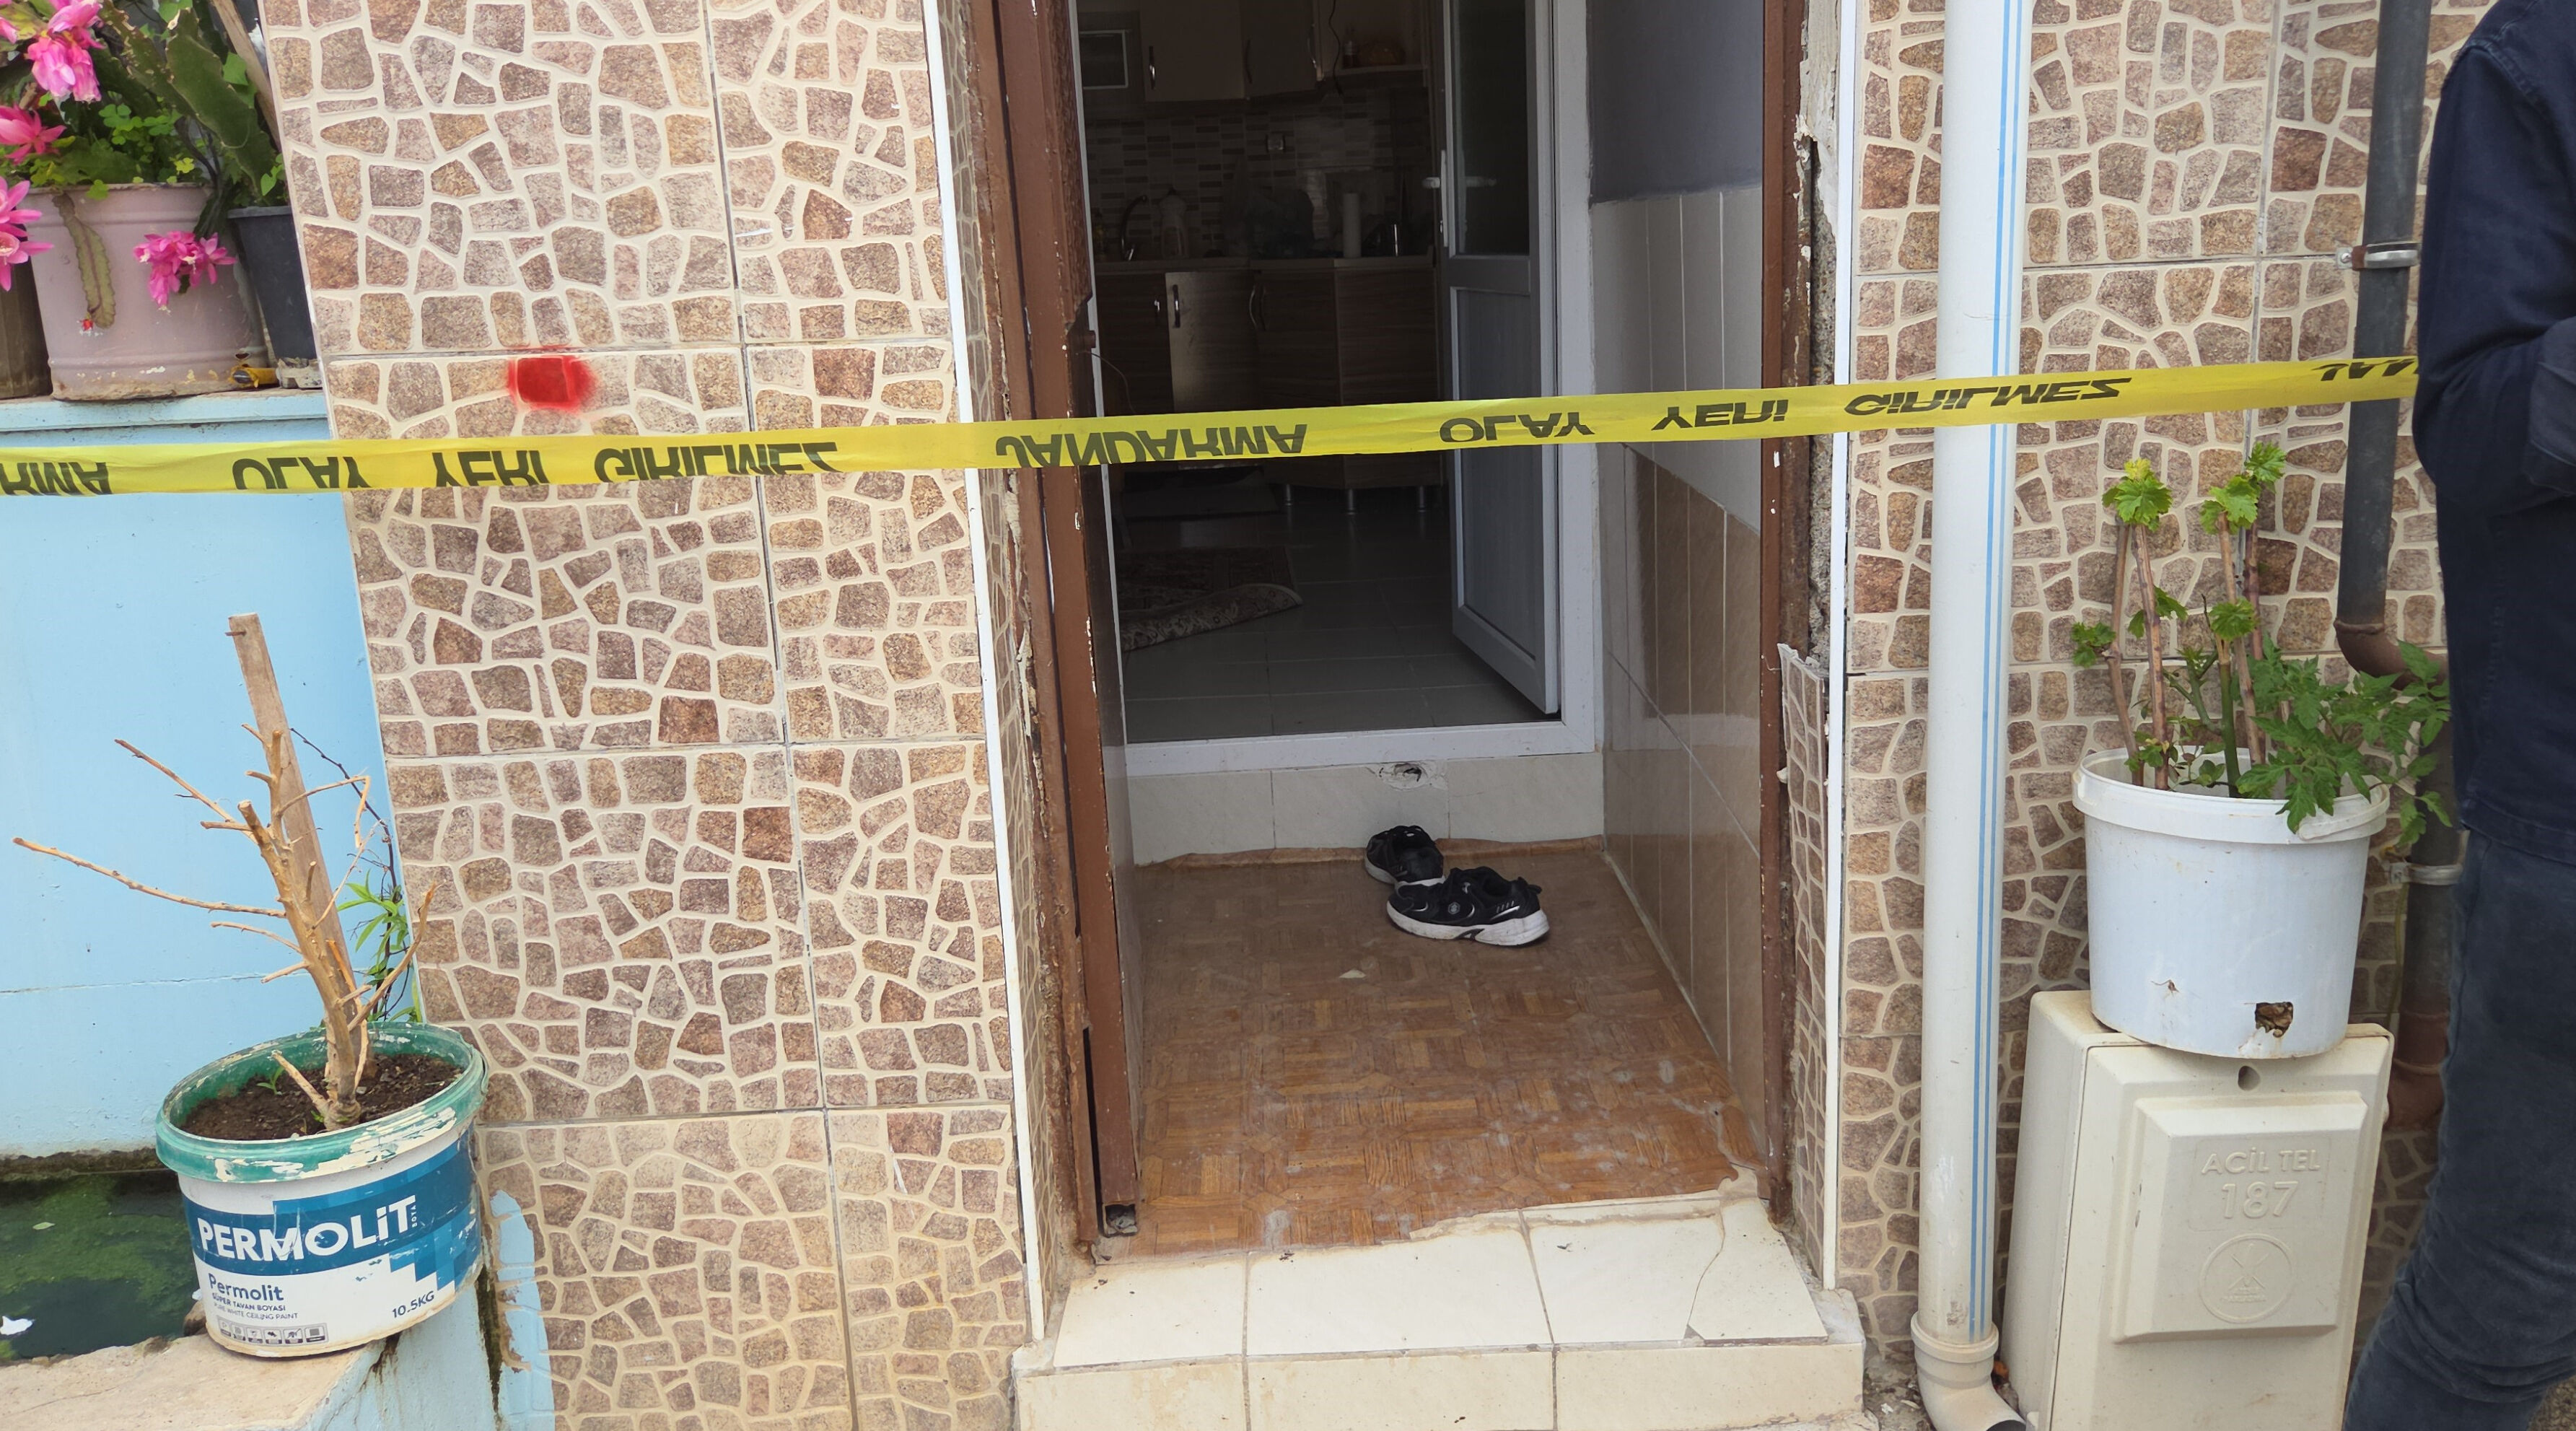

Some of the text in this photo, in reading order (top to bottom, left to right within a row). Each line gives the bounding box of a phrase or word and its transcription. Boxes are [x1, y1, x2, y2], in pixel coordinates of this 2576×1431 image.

[2279, 1149, 2321, 1173] TEL
[2220, 1180, 2299, 1220] 187
[208, 1272, 285, 1302] Permolit
